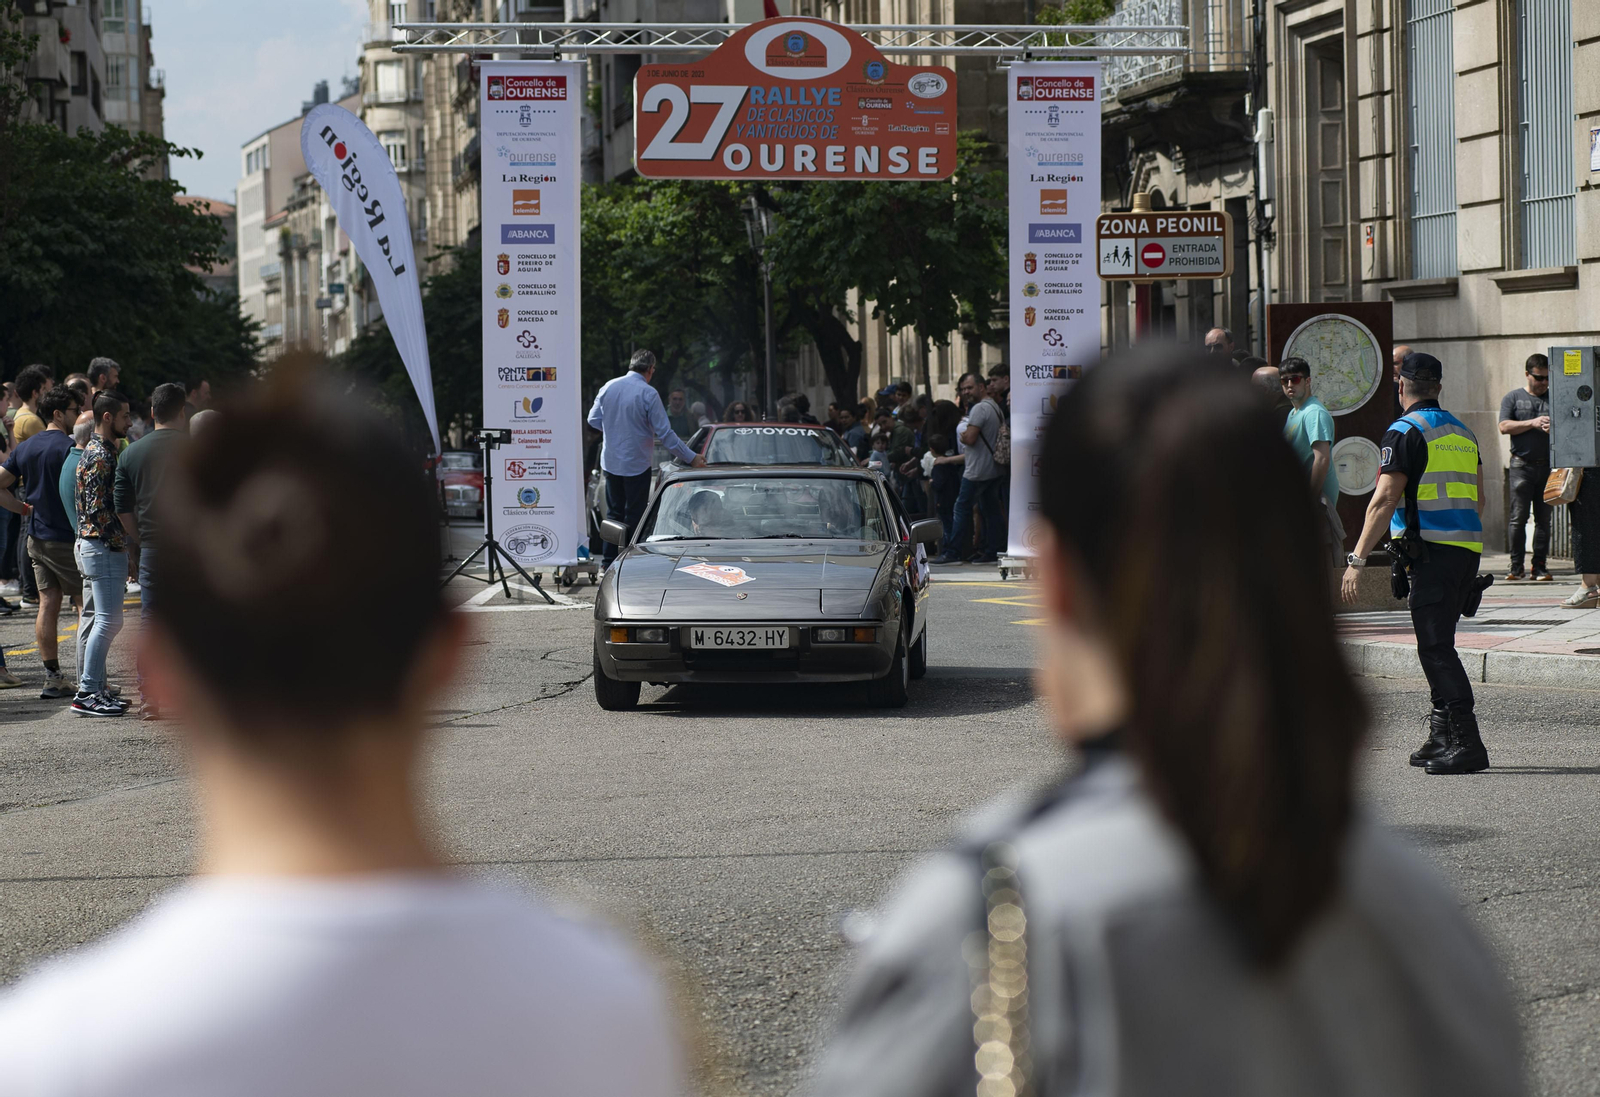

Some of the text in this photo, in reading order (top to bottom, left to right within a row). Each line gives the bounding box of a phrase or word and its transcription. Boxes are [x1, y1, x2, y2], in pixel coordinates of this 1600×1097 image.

[506, 78, 556, 87] Concello de
[1036, 79, 1084, 87] Concello de
[506, 88, 566, 98] OURENSE
[875, 86, 905, 94] Ourense
[1035, 88, 1093, 98] OURENSE
[750, 86, 842, 106] RALLYE
[747, 107, 836, 123] DE CLASICOS
[640, 83, 749, 161] 27
[736, 124, 839, 139] Y ANTIGUOS DE
[903, 125, 930, 133] Región
[509, 152, 556, 162] ourense
[723, 143, 939, 174] OURENSE
[1037, 152, 1084, 162] ourense
[502, 174, 556, 184] La Región
[1030, 174, 1083, 184] La Región
[1100, 217, 1223, 235] ZONA PEONIL
[509, 230, 549, 238] ABANCA
[1036, 229, 1075, 237] ABANCA
[1172, 244, 1217, 253] ENTRADA
[1169, 256, 1221, 266] PROHIBIDA
[498, 367, 527, 375] PONTE
[498, 374, 527, 382] VELLA
[751, 427, 819, 437] TOYOTA
[1435, 444, 1458, 452] POLICIA
